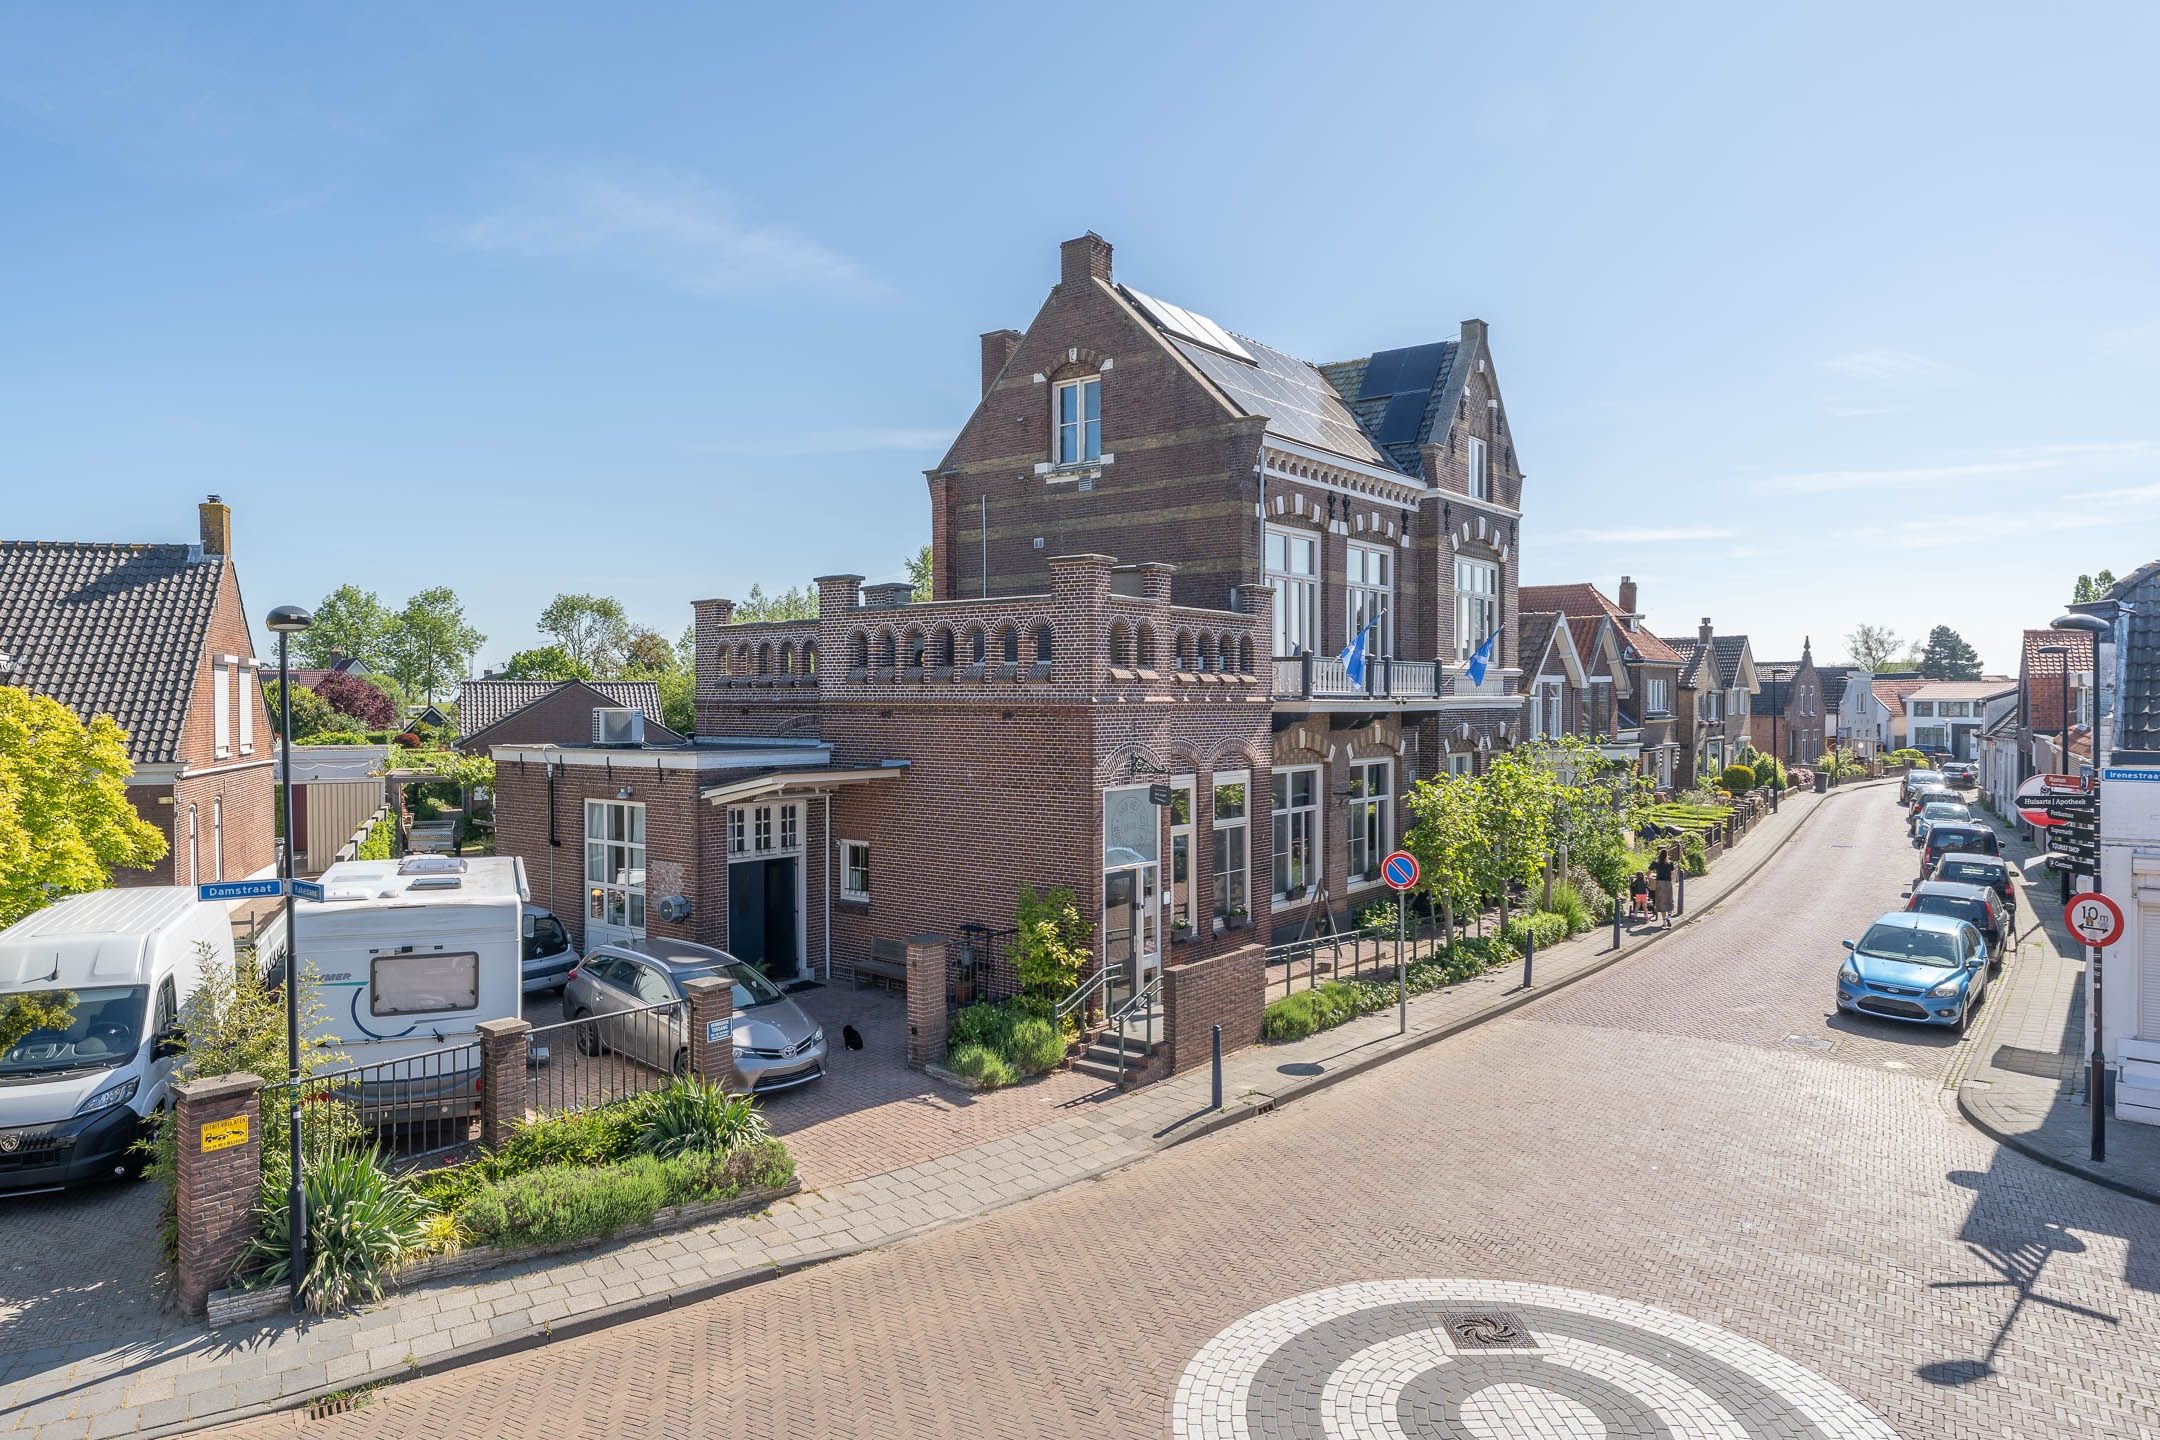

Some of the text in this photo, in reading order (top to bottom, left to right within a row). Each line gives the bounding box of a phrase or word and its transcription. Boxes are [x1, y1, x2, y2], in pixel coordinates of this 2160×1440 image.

[2055, 798, 2087, 806] Apotheek
[2069, 845, 2080, 853] SHOP
[209, 884, 272, 896] Damstraat
[2082, 906, 2098, 920] 10
